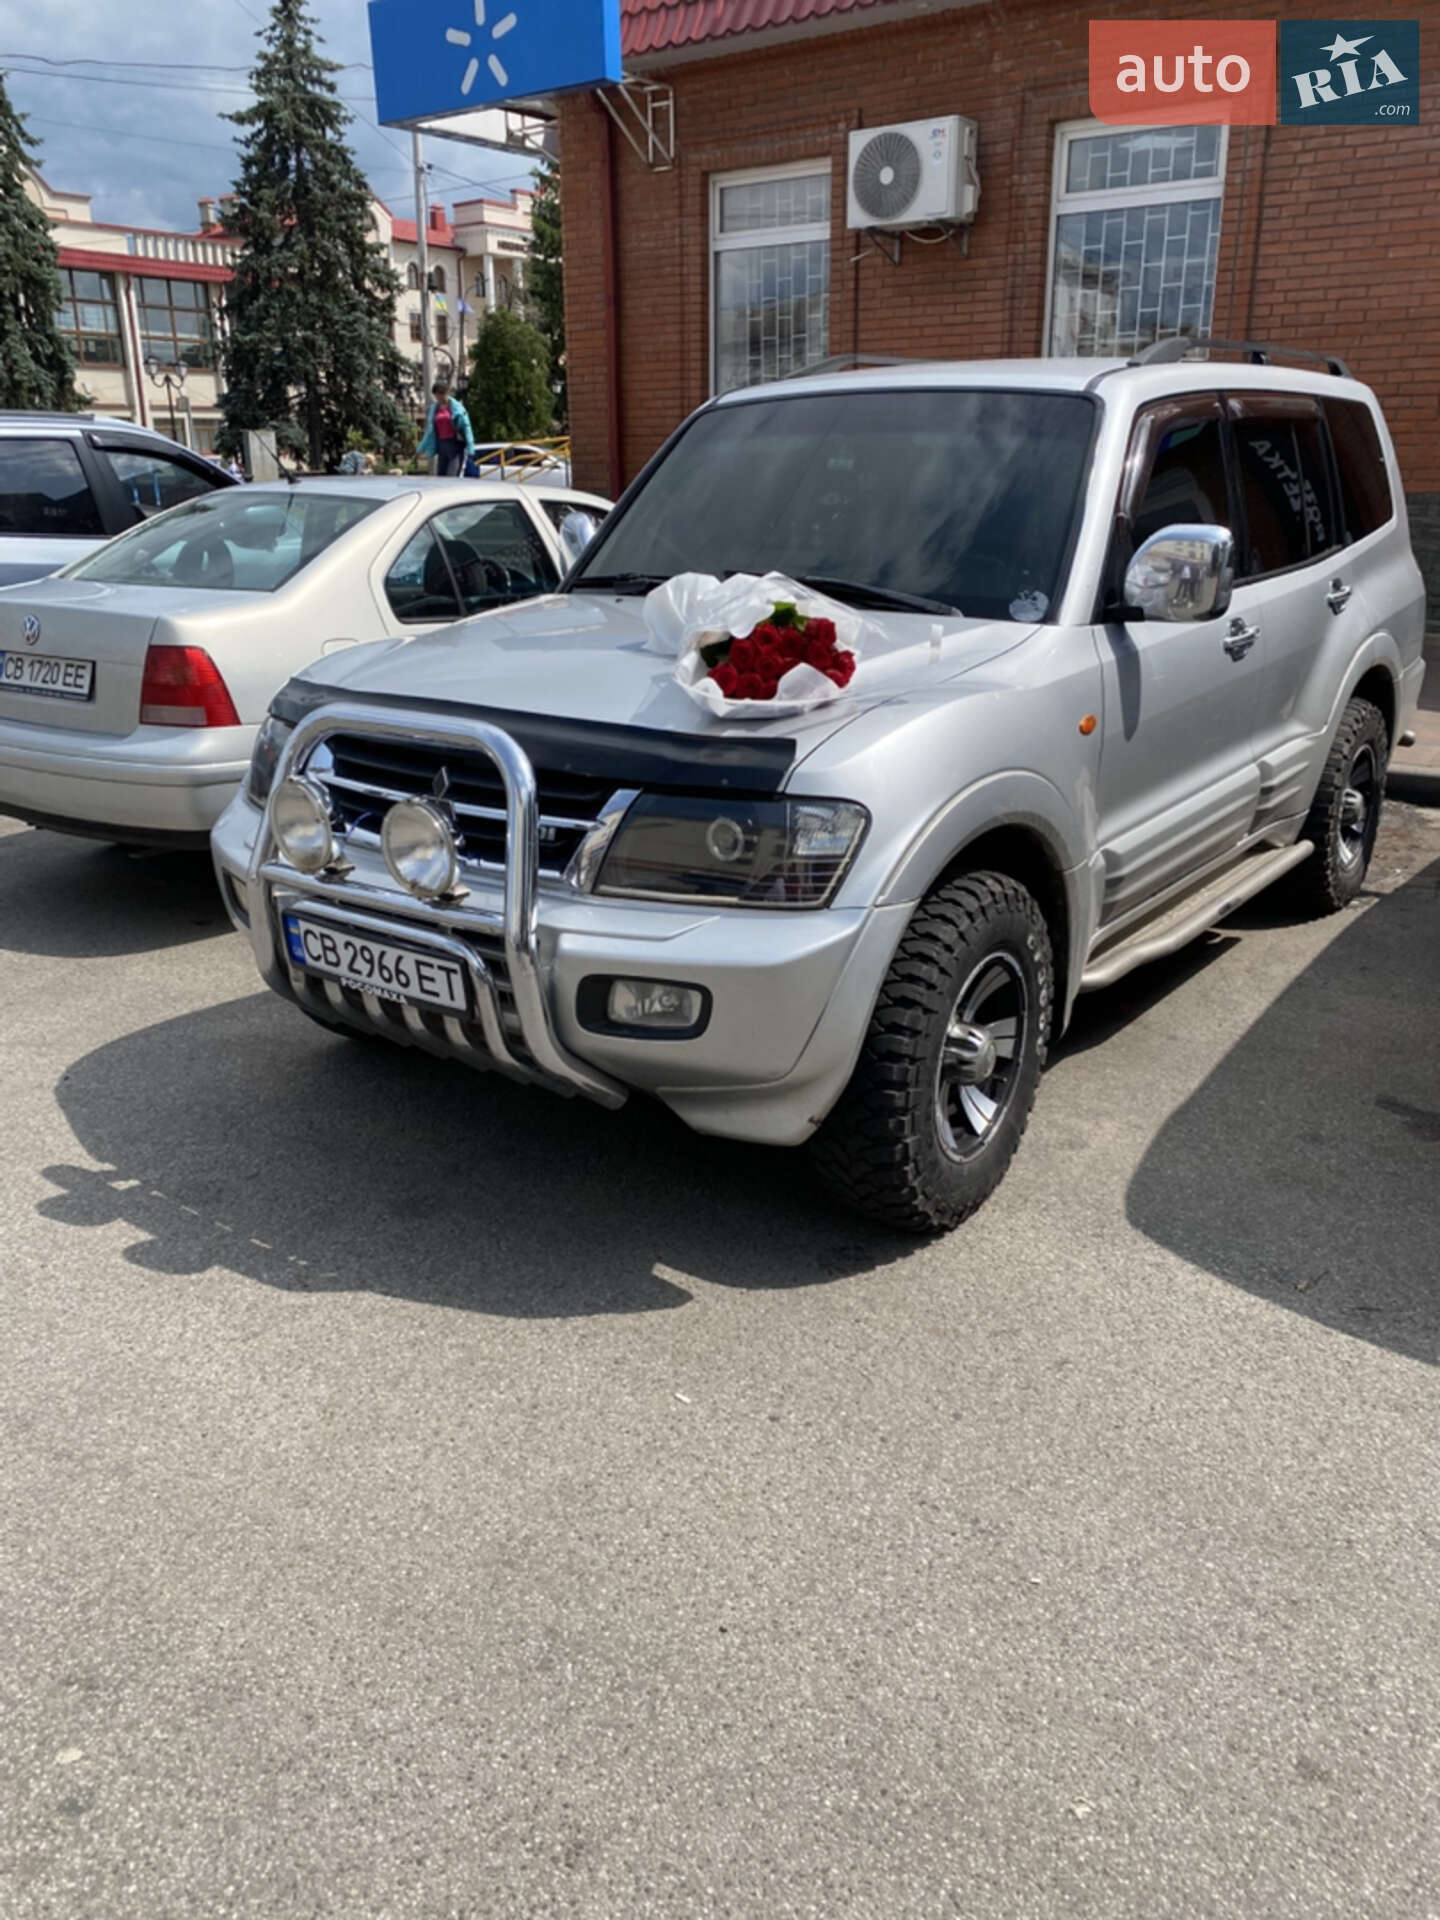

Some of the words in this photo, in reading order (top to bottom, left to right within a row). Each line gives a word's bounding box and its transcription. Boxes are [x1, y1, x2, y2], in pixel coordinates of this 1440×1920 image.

[5, 656, 24, 680] CB
[28, 659, 61, 685] 1720
[62, 662, 86, 689] EE
[303, 929, 341, 968] CB
[344, 941, 410, 988] 2966
[415, 959, 458, 1001] ET
